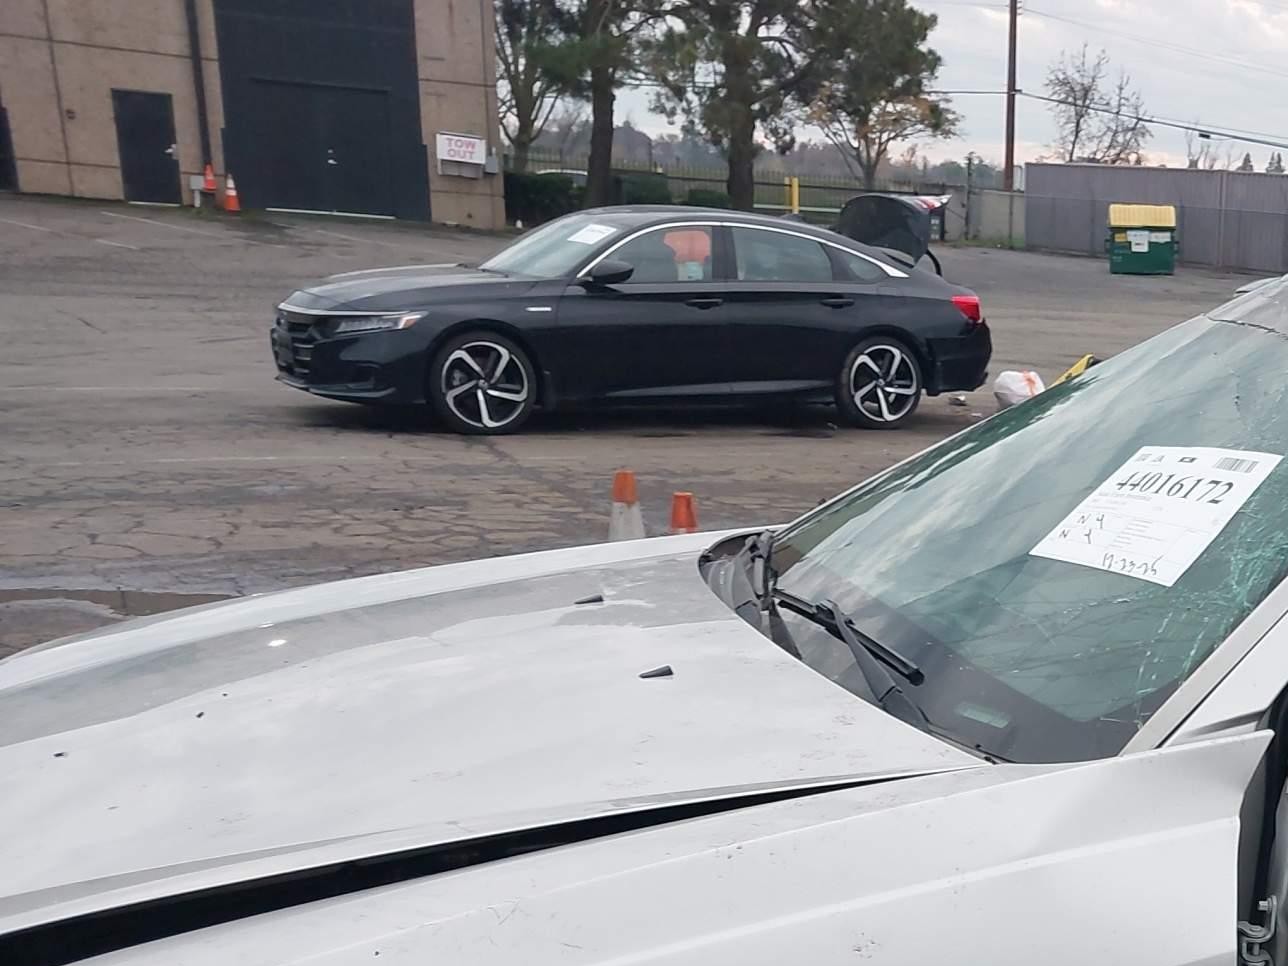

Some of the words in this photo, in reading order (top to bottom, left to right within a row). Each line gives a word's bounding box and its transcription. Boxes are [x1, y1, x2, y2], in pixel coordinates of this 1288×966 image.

[446, 138, 476, 149] TOW
[447, 149, 474, 159] OUT
[1116, 471, 1234, 504] 44016172
